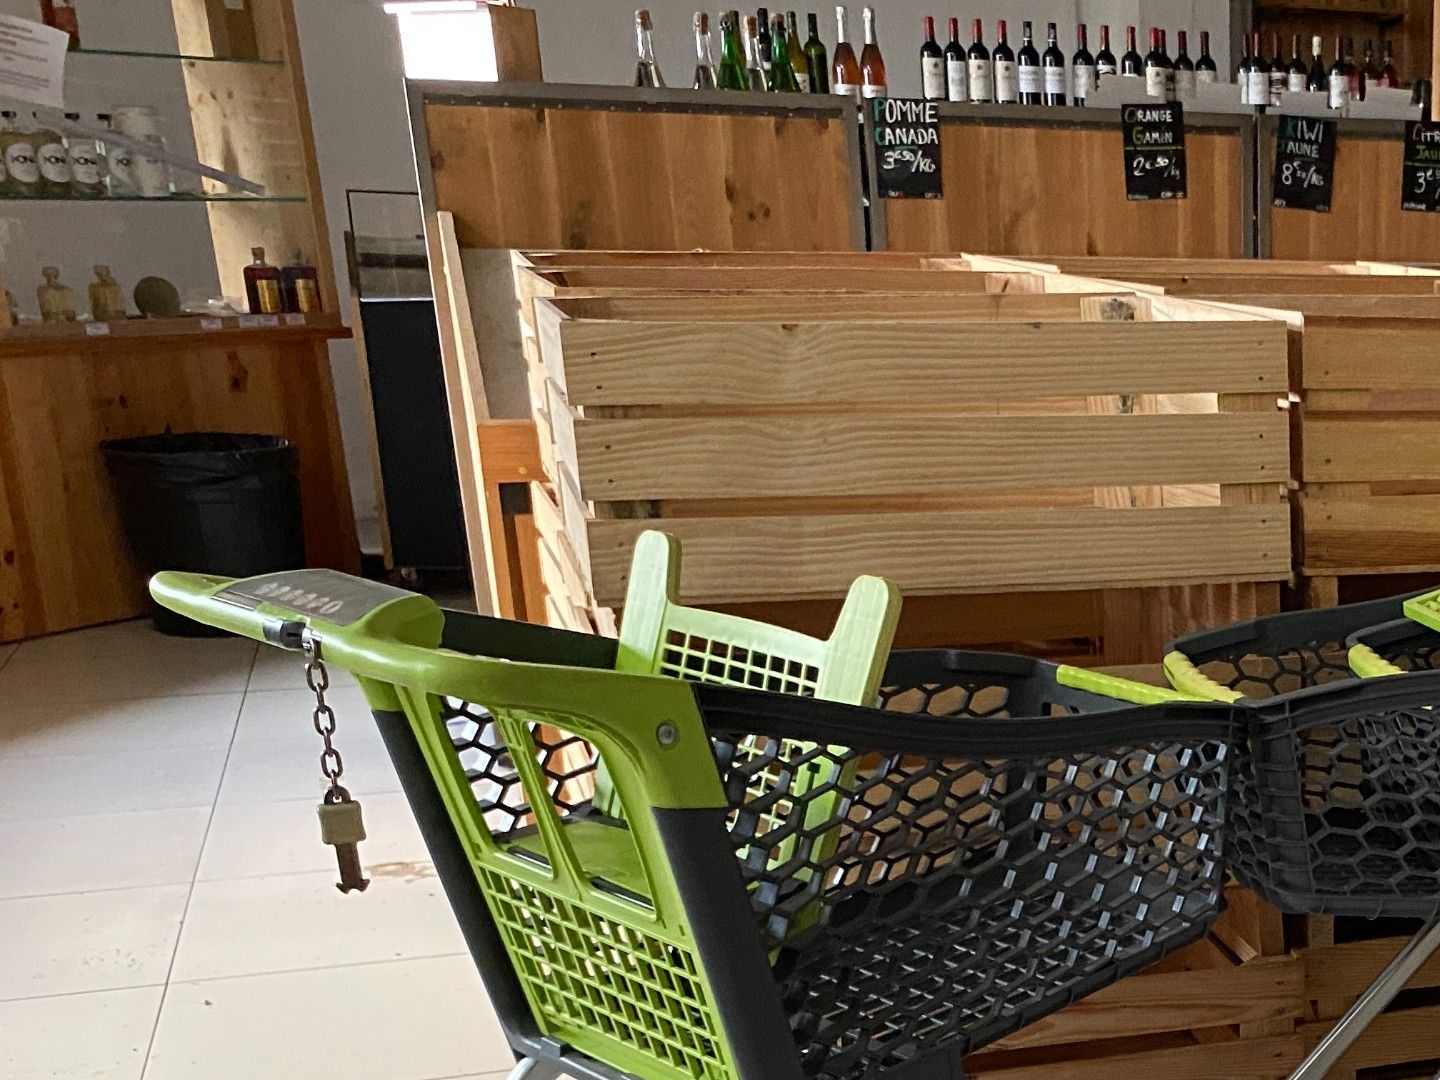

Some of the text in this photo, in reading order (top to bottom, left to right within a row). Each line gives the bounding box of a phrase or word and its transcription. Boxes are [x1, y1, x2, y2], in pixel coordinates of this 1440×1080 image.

[873, 98, 939, 124] POMME
[1124, 106, 1173, 123] ORANGE
[874, 127, 939, 146] CANADA
[1285, 116, 1323, 143] KIWI
